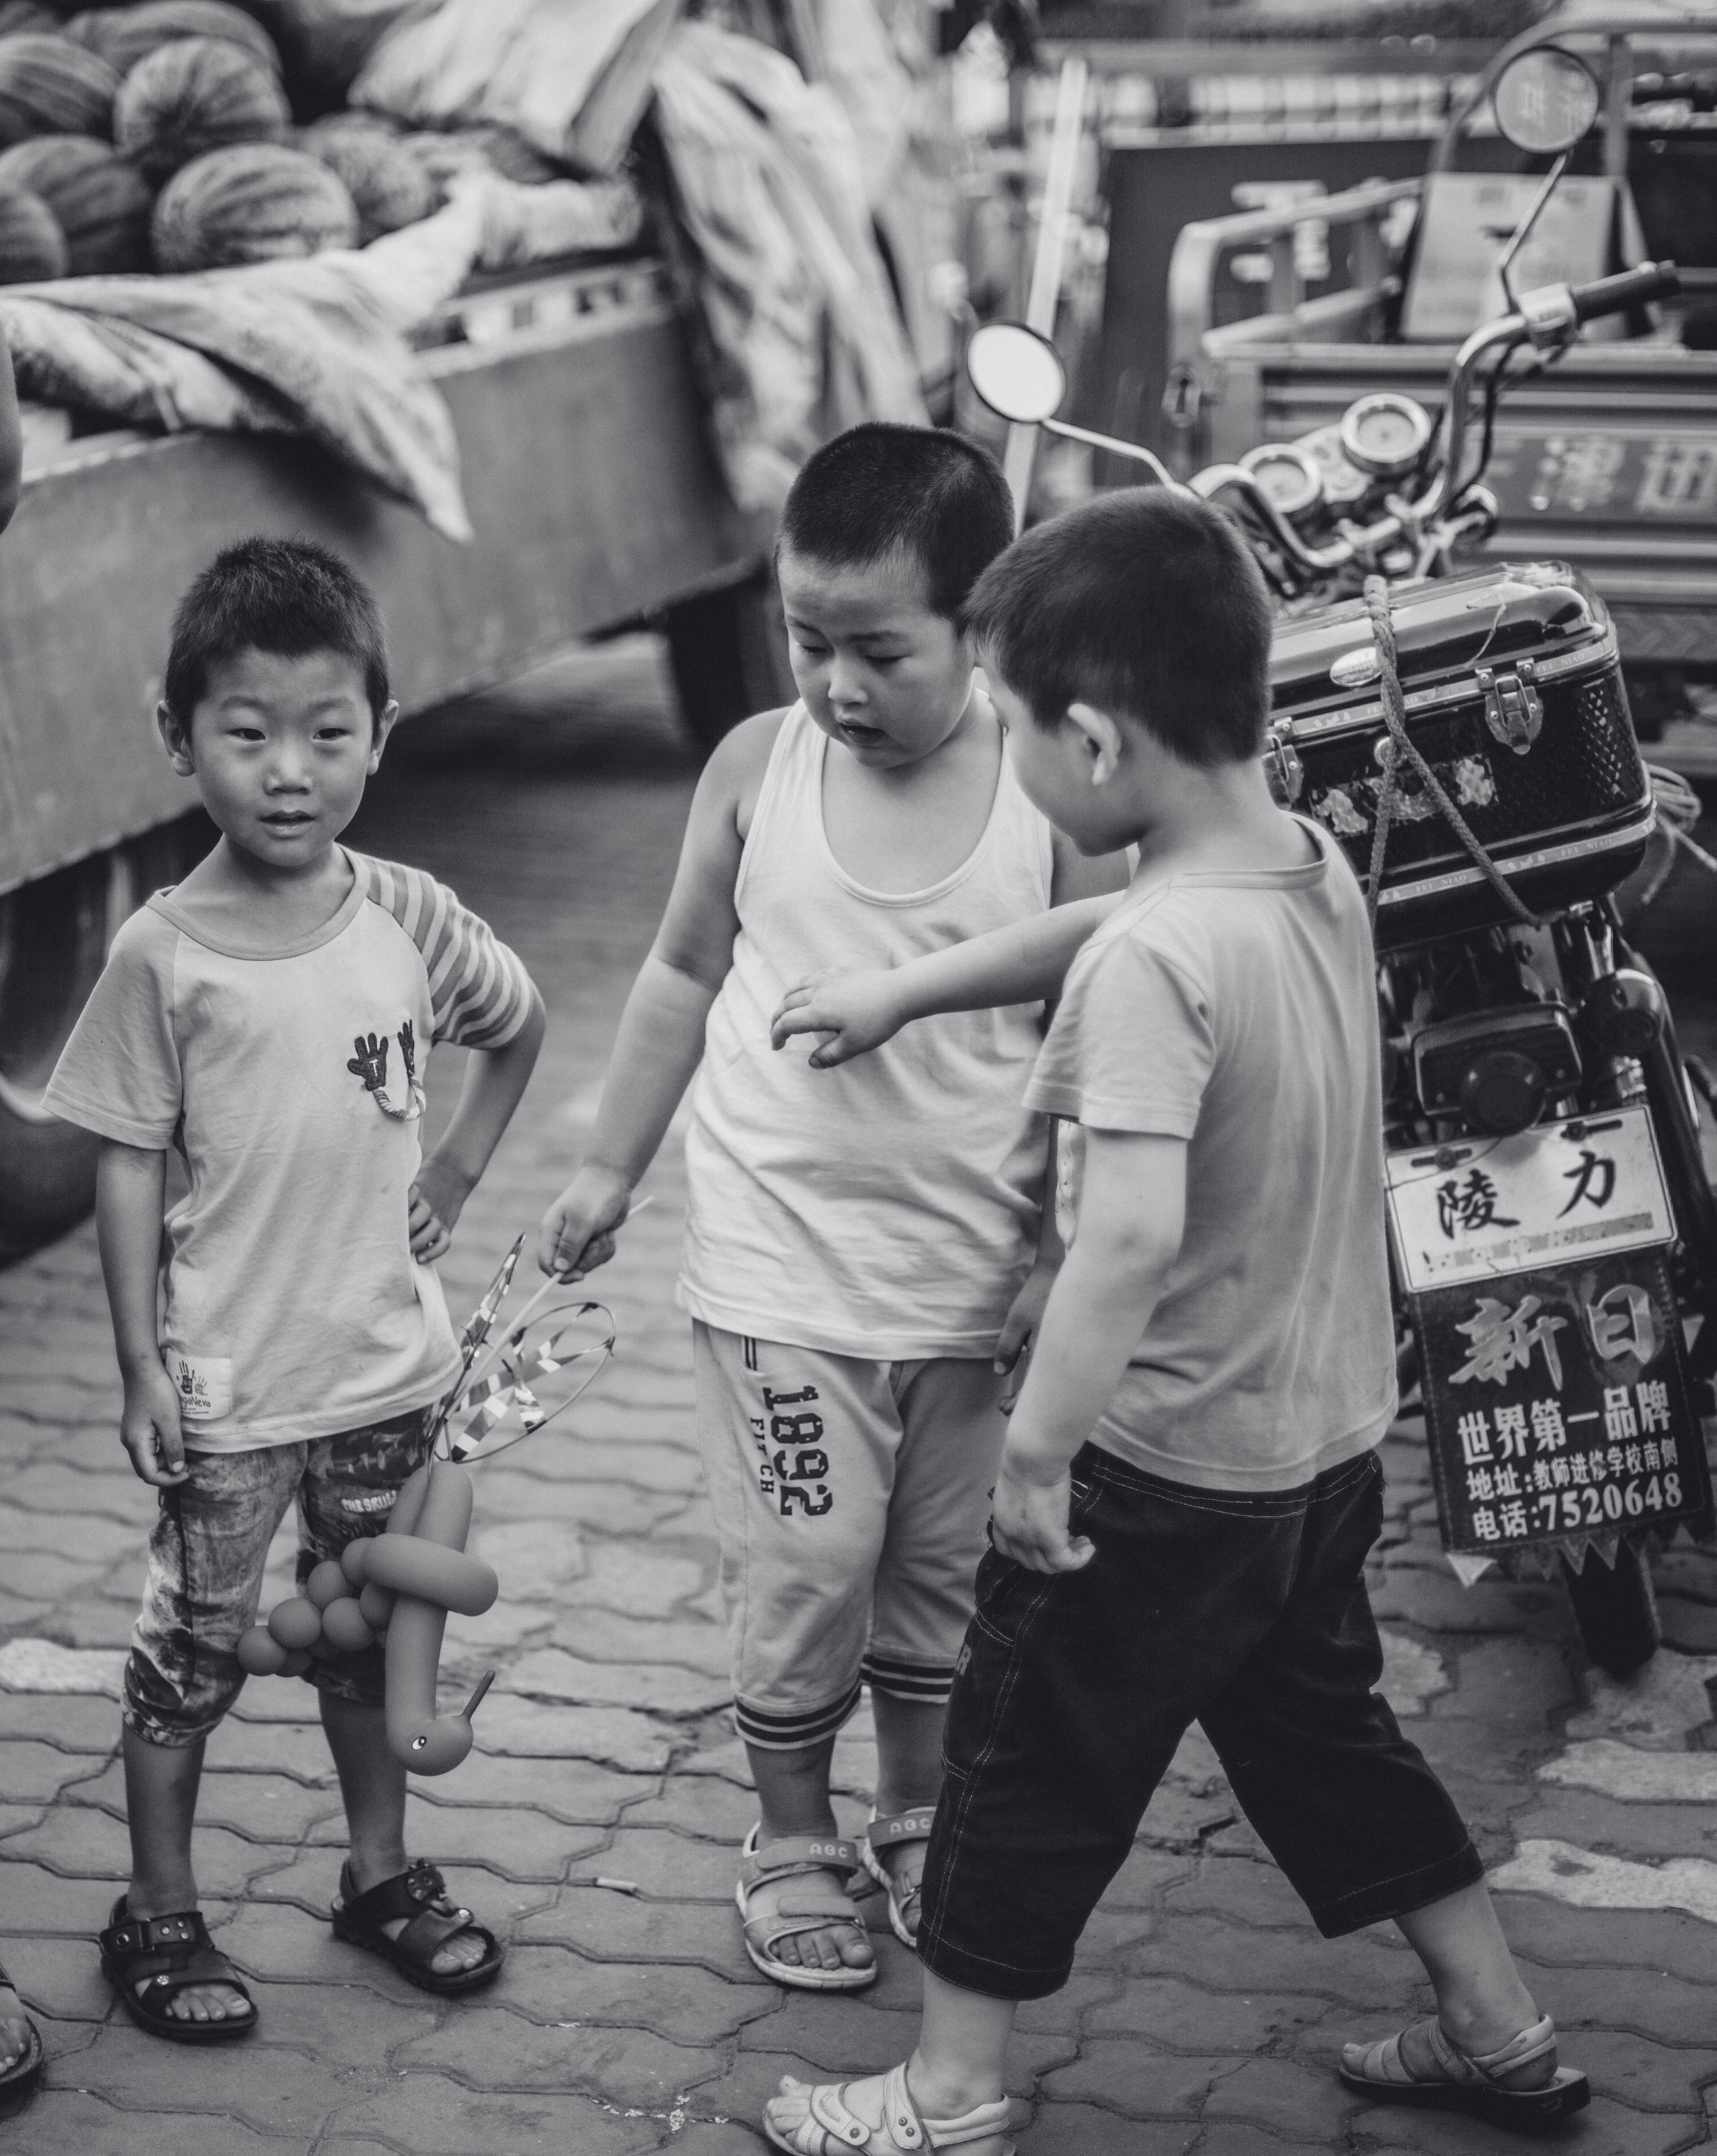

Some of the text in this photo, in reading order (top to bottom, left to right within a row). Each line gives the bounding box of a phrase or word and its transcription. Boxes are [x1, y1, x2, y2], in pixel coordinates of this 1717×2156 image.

[762, 1385, 833, 1517] 1892
[1457, 1379, 1673, 1466] 世界第一品牌
[808, 1843, 848, 1858] ABC
